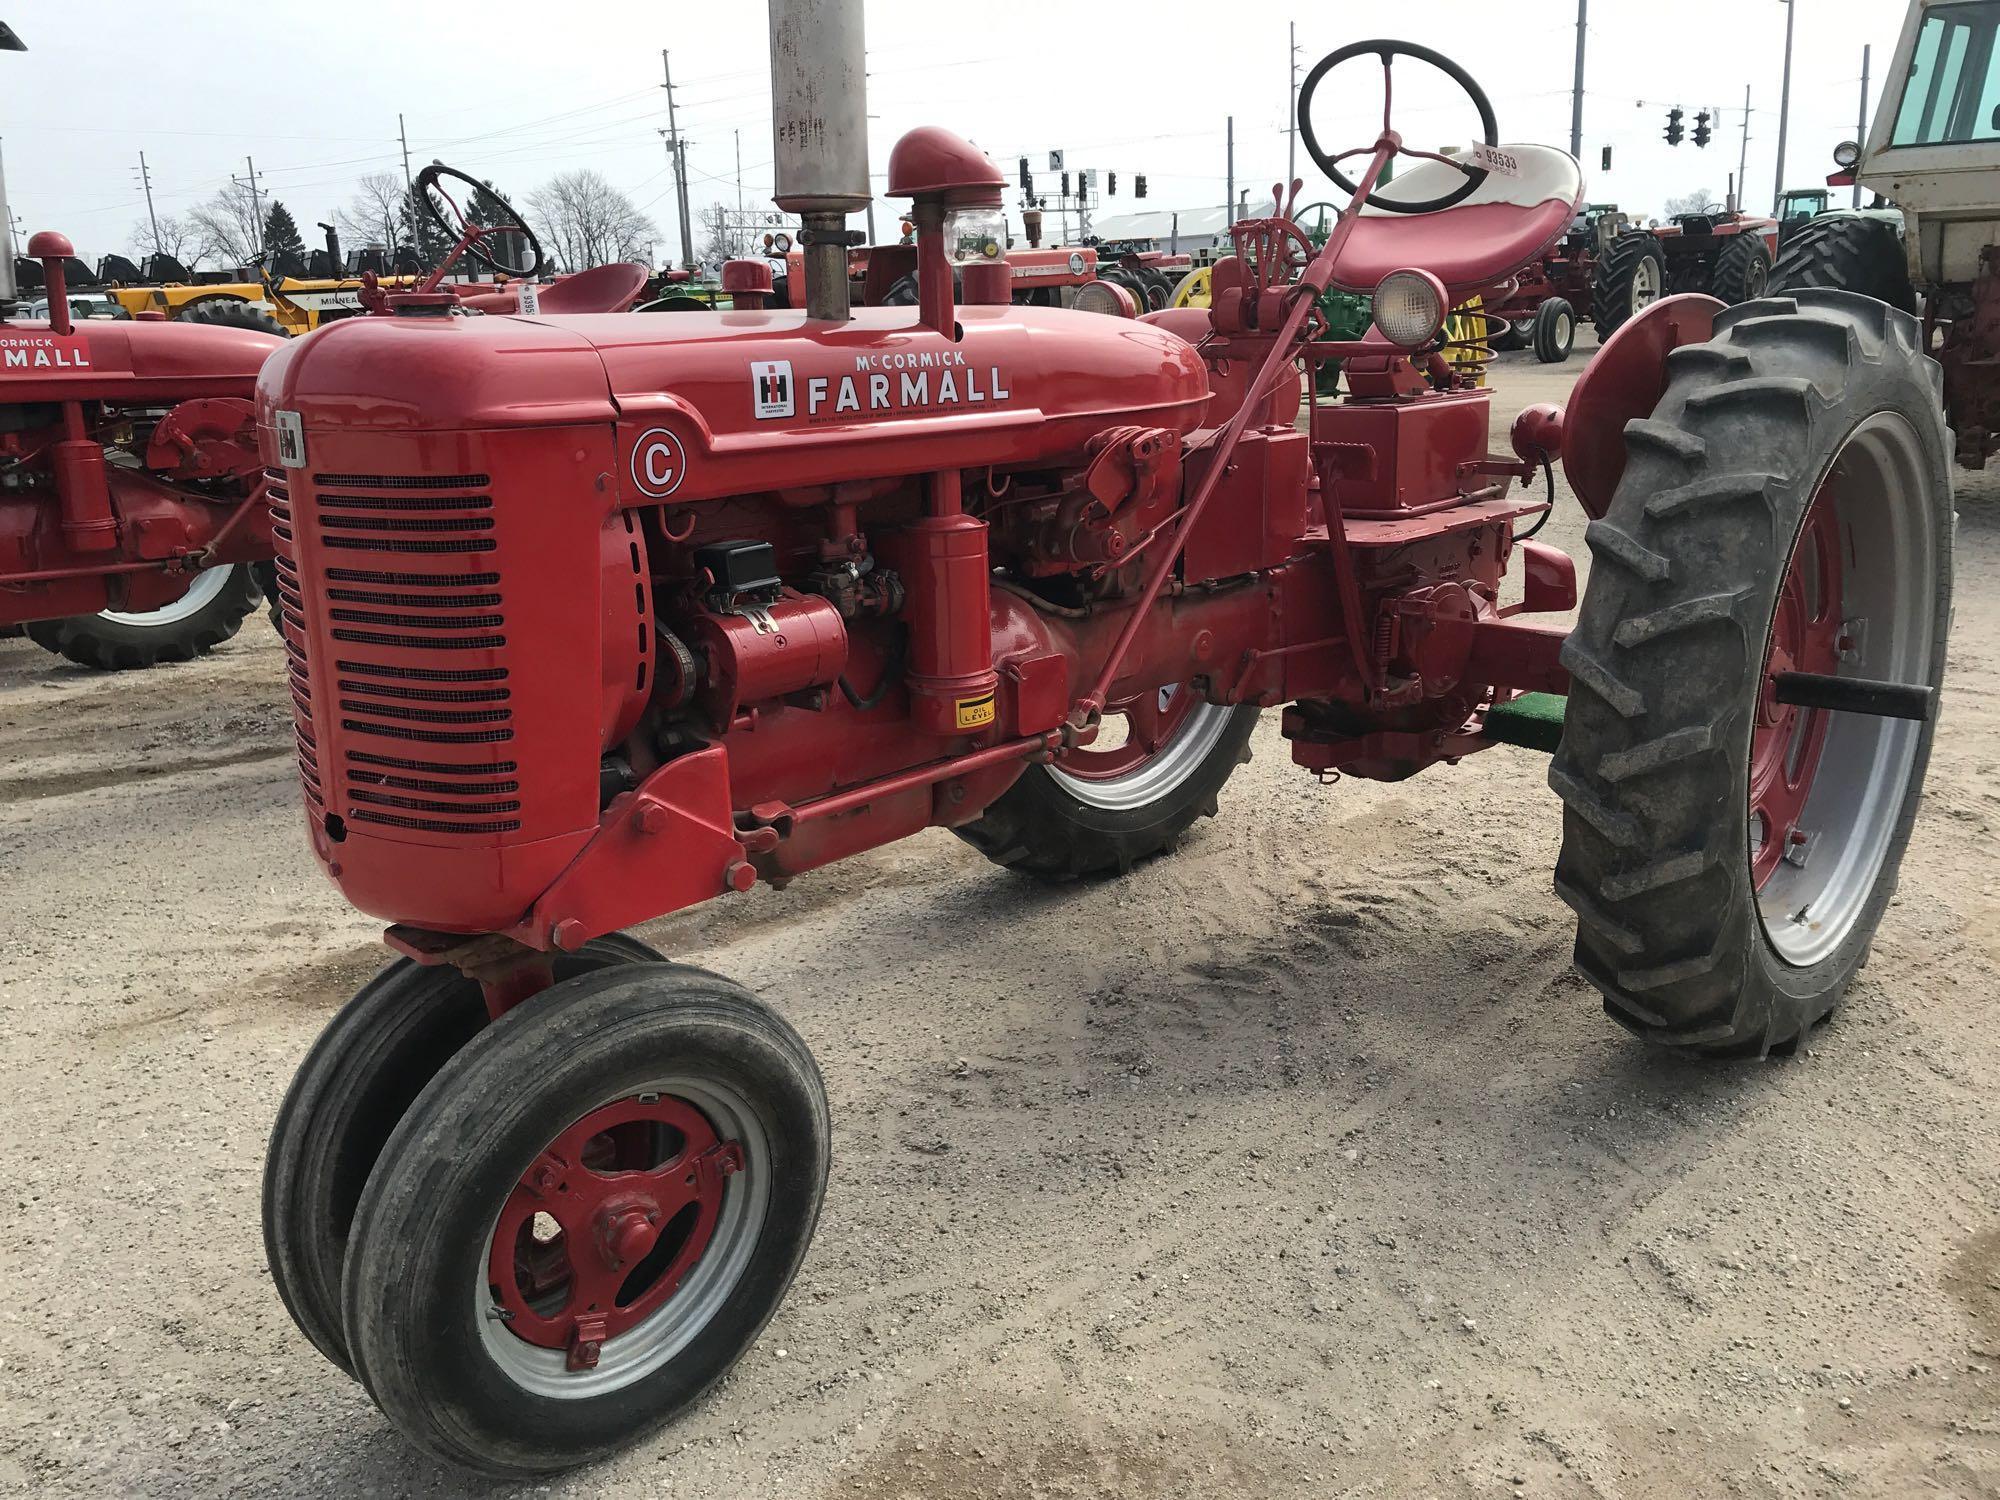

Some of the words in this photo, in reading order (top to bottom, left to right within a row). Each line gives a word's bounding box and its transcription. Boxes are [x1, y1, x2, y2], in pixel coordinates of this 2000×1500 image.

[1486, 150, 1516, 169] 93533
[321, 297, 357, 305] MINNEA
[523, 295, 535, 315] 9395
[0, 339, 54, 347] ORMICK
[3, 349, 90, 367] MALL
[808, 367, 1009, 415] FARMALL
[645, 443, 672, 485] C
[965, 711, 993, 721] LEVEL
